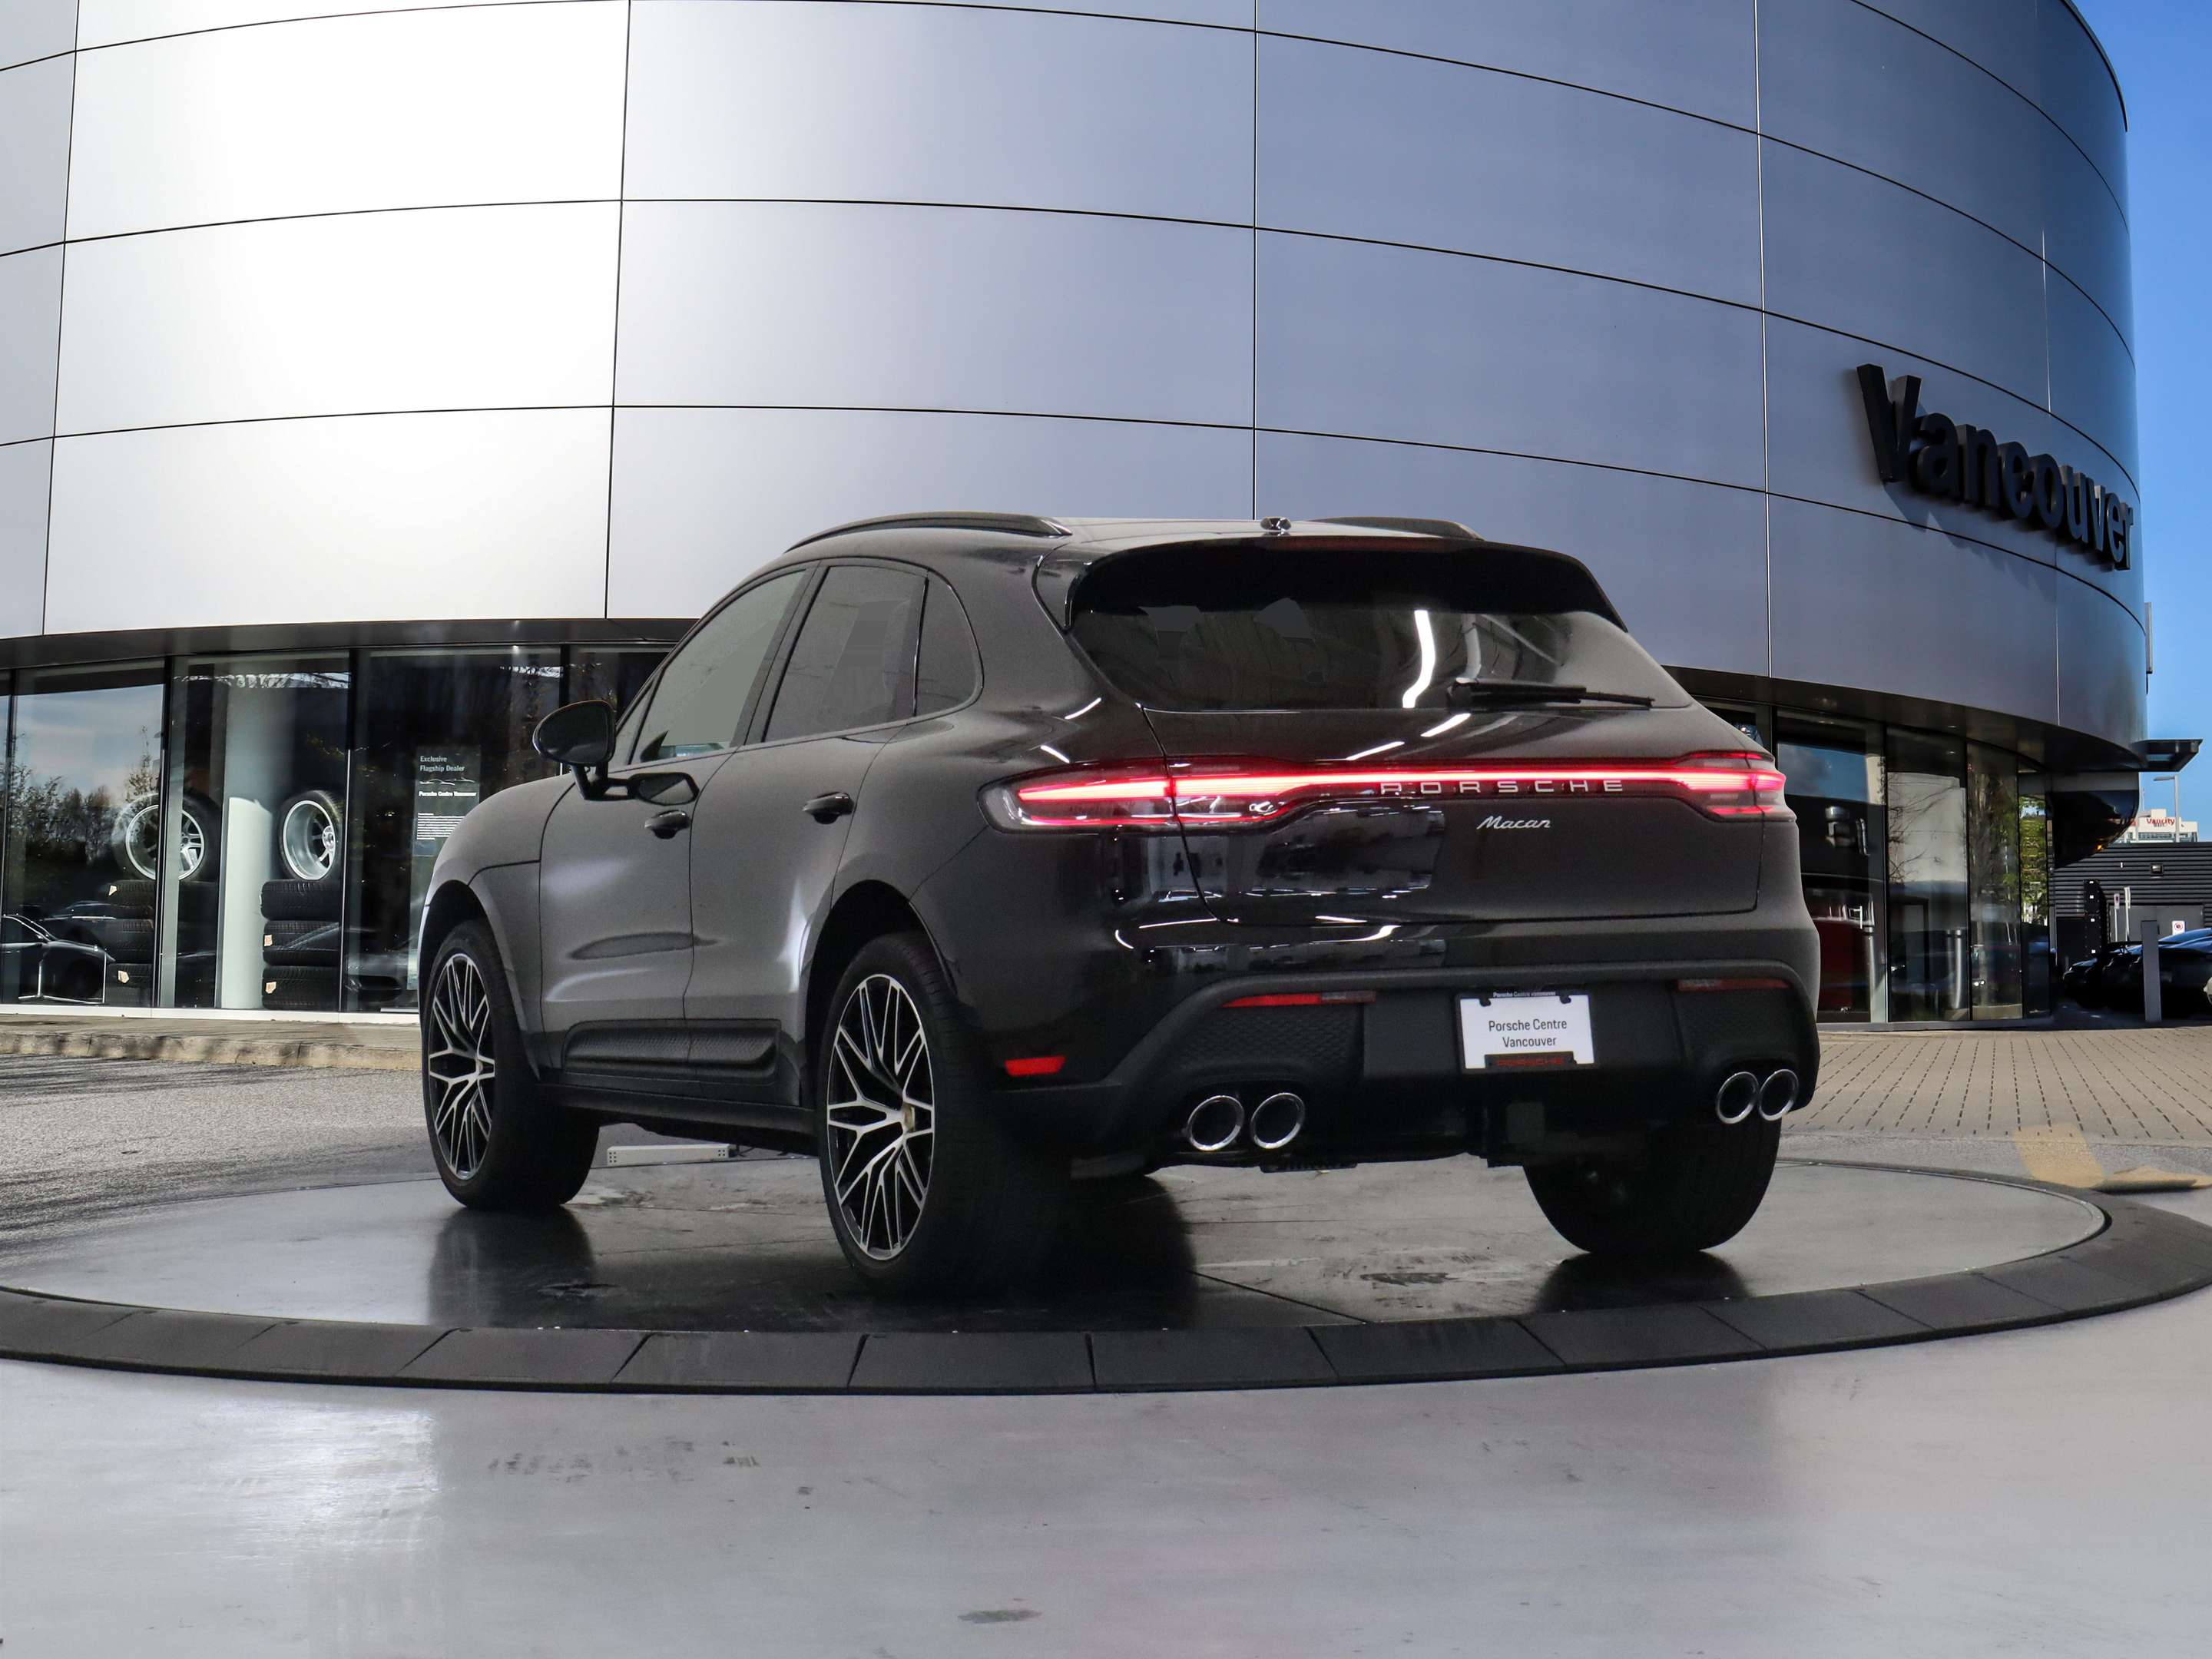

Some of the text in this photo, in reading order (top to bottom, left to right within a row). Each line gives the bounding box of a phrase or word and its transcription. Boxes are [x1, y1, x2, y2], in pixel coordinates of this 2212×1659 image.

[1856, 363, 2134, 570] Vancouver
[1380, 780, 1623, 794] PORSCHE
[1476, 816, 1551, 830] Macan
[1488, 1018, 1568, 1031] Porsche Centre
[1502, 1037, 1557, 1048] Vancouver
